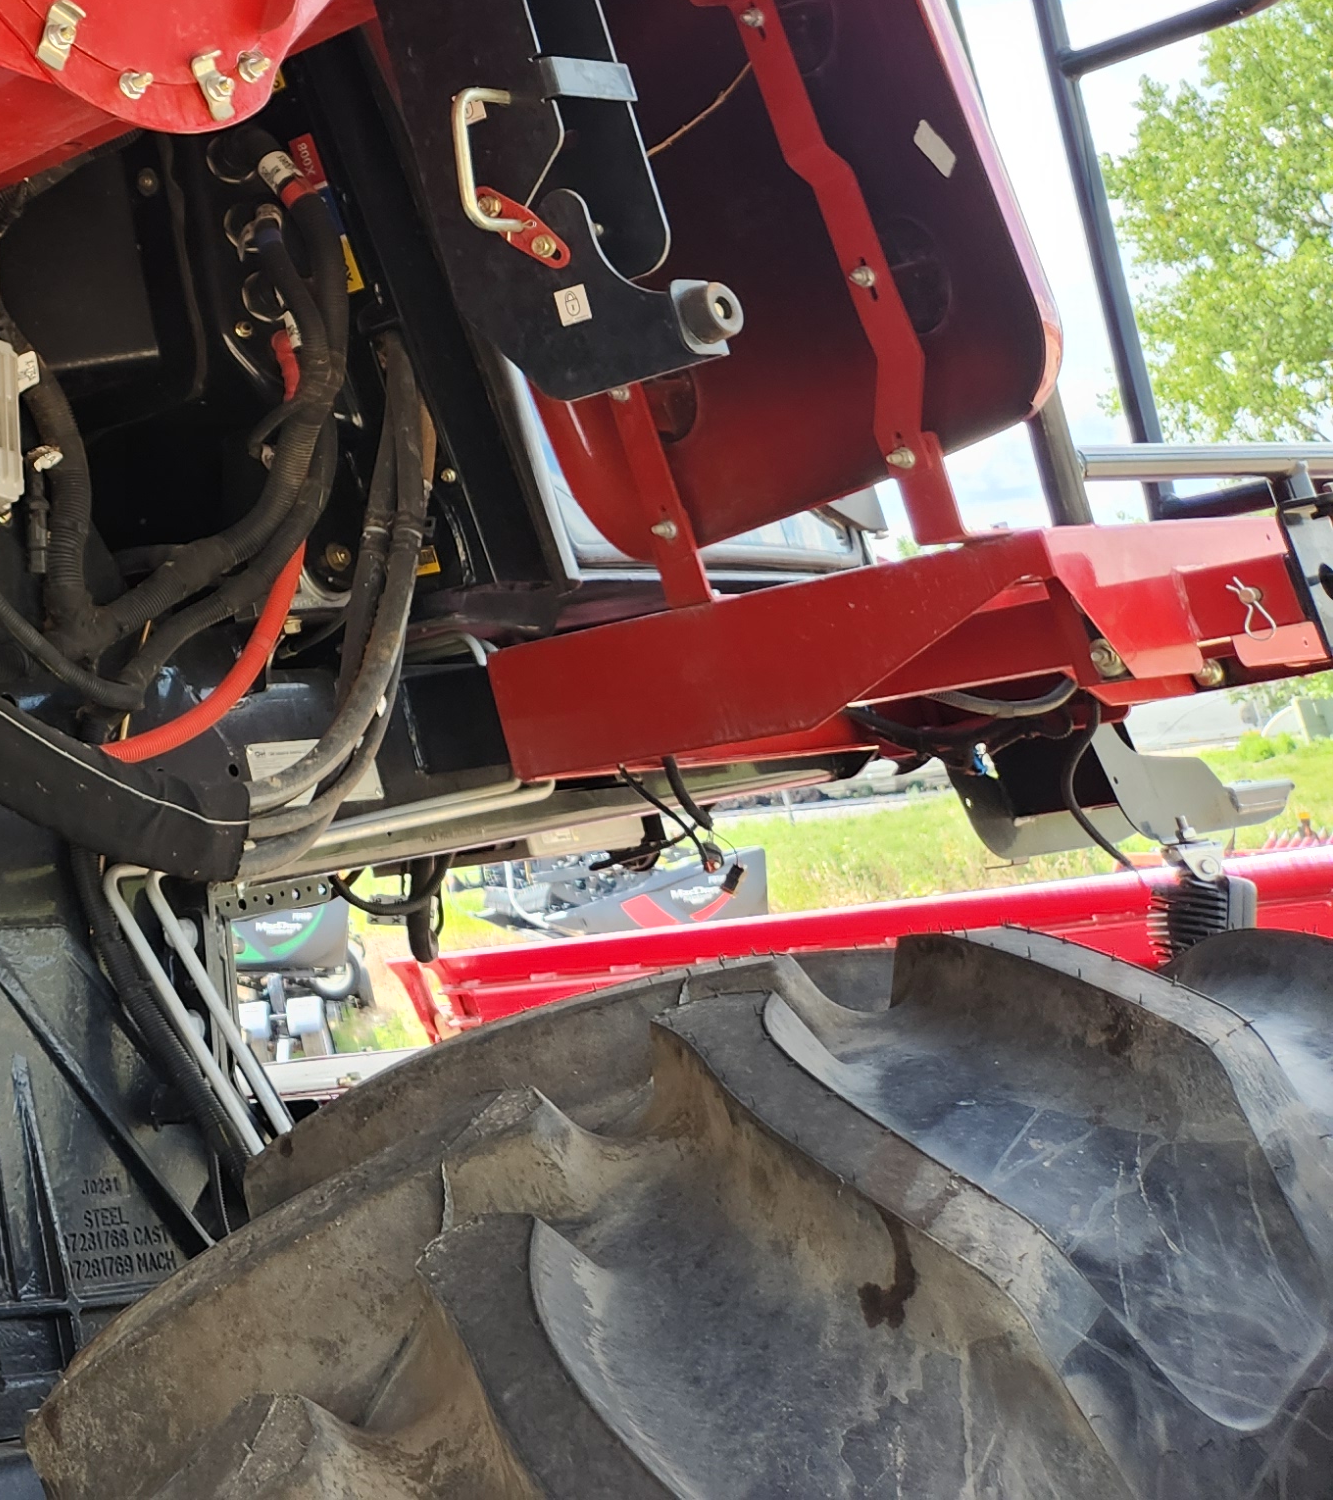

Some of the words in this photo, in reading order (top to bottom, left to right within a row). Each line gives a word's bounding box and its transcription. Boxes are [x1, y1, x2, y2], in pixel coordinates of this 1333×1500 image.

[84, 1206, 129, 1229] STEEL
[132, 1225, 169, 1246] CAST
[136, 1250, 177, 1274] MACH
